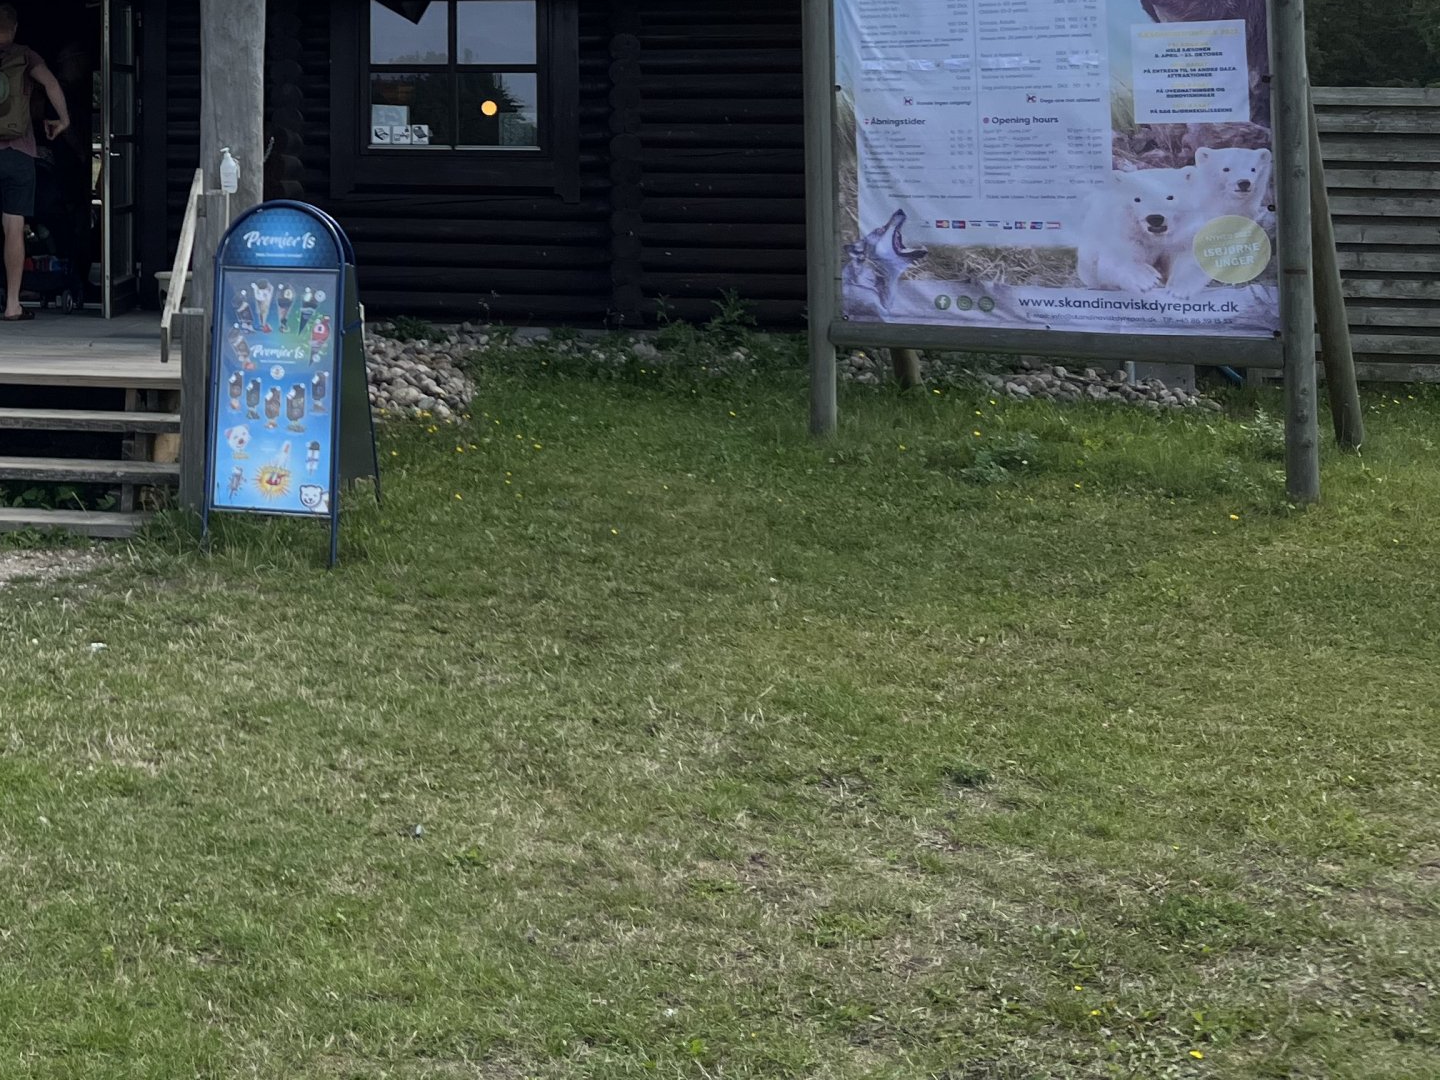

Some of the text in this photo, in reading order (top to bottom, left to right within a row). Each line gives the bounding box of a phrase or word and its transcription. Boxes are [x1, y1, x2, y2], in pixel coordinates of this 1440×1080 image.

[870, 117, 926, 127] Åbningstider
[991, 116, 1031, 125] Opening
[243, 230, 301, 249] Premier
[1215, 255, 1255, 268] UNGER
[1018, 296, 1239, 315] www.skandinaviskdyrepark.dk
[250, 344, 294, 358] Premier
